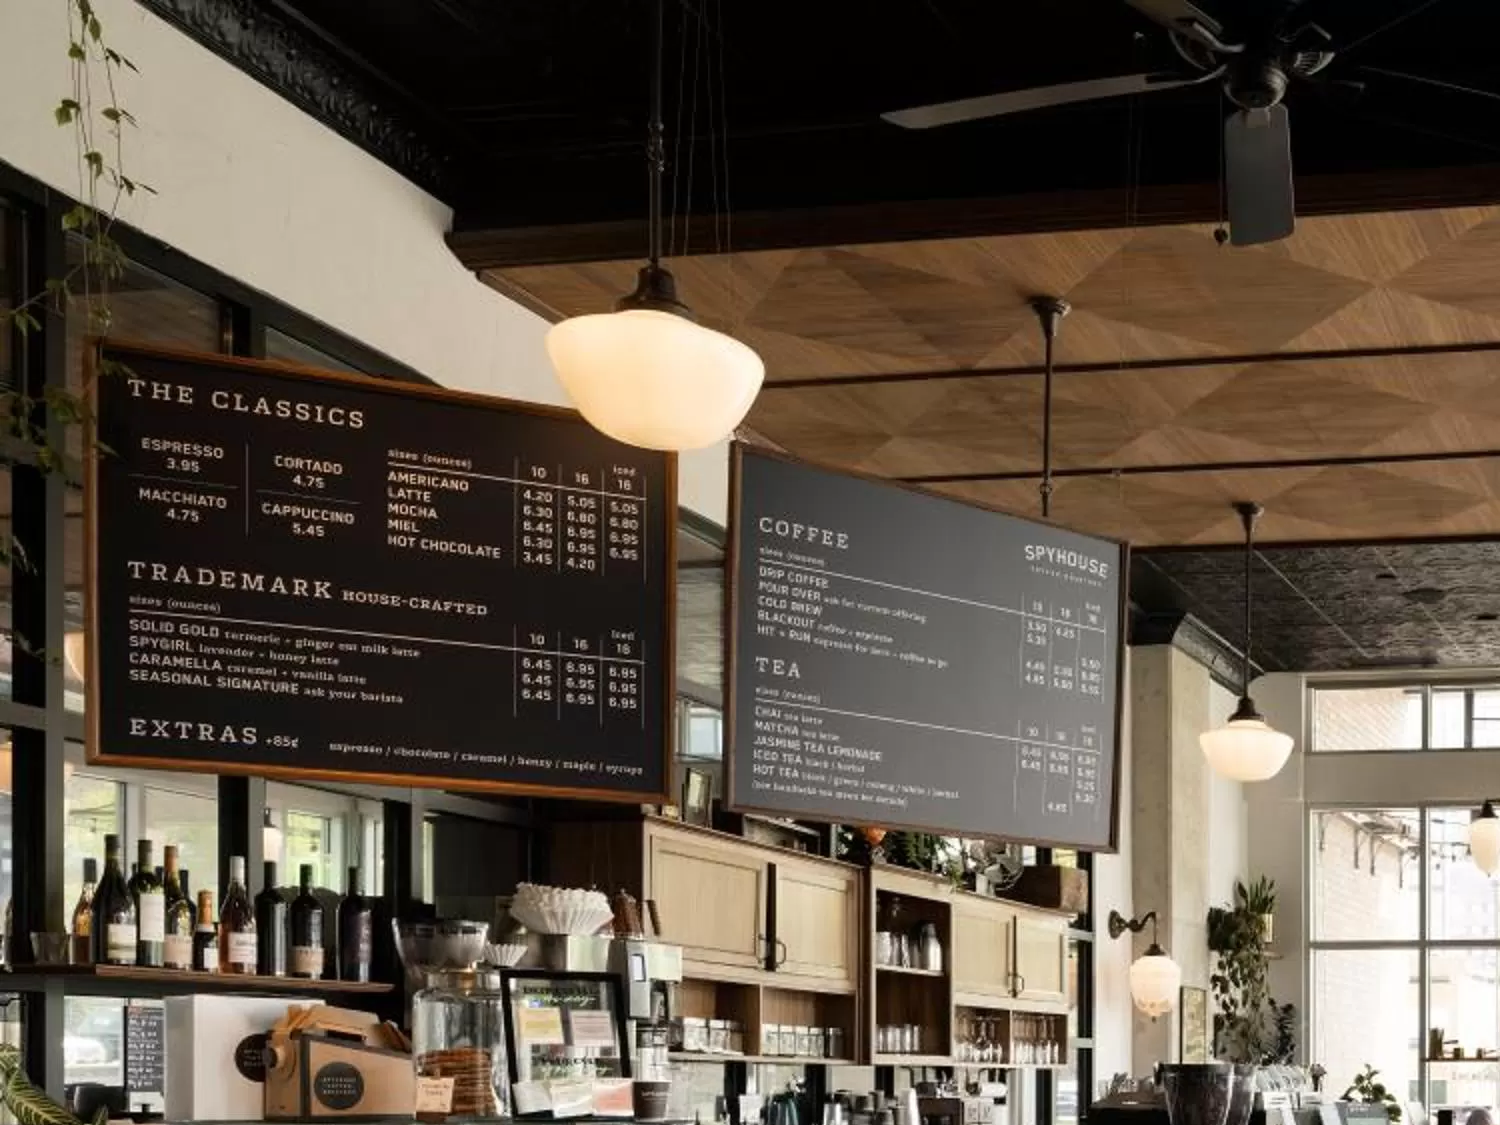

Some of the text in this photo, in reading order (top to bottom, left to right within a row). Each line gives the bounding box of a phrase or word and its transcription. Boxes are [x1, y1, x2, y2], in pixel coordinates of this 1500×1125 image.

[128, 379, 364, 428] THE CLASSICS
[141, 437, 224, 459] ESPRESSO
[166, 457, 200, 473] 3.95
[274, 454, 343, 475] CORTADO
[530, 466, 547, 479] 10
[292, 474, 326, 489] 4.75
[387, 470, 469, 492] AMERICANO
[139, 487, 227, 509] MACCHIATO
[387, 487, 432, 502] LATTE
[523, 489, 553, 503] 4.20
[166, 508, 200, 523] 4.75
[261, 502, 355, 525] CAPPUCCINO
[387, 503, 438, 519] MOCHA
[292, 523, 325, 537] 5.45
[387, 519, 420, 533] MIEL
[759, 516, 850, 550] COFFEE
[387, 535, 501, 559] HOT CHOCOLATE
[523, 551, 553, 565] 3.45
[1024, 545, 1109, 579] SPYHOUSE
[127, 561, 488, 616] TRADEMARK HOUSE-CRAFTED
[759, 567, 830, 589] DRIP COFFEE
[758, 581, 789, 596] POUR
[791, 587, 821, 602] OVER
[757, 595, 787, 610] COLD
[757, 609, 816, 629] BLACKOUT
[129, 618, 175, 635] SOLID
[179, 622, 220, 639] GOLD
[361, 643, 388, 655] milk
[528, 633, 545, 646] 10
[129, 635, 194, 653] SPYGIRL
[269, 650, 307, 666] honey
[129, 652, 222, 672] CARAMELLA
[755, 656, 801, 679] TEA
[129, 669, 404, 704] SEASONAL SIGNATURE ask your barista
[129, 717, 258, 746] EXTRAS
[754, 720, 799, 736] MATCHA
[753, 735, 884, 762] JASMINE TEA LEMONADE
[753, 764, 775, 776] HOT
[779, 767, 799, 779] TEA
